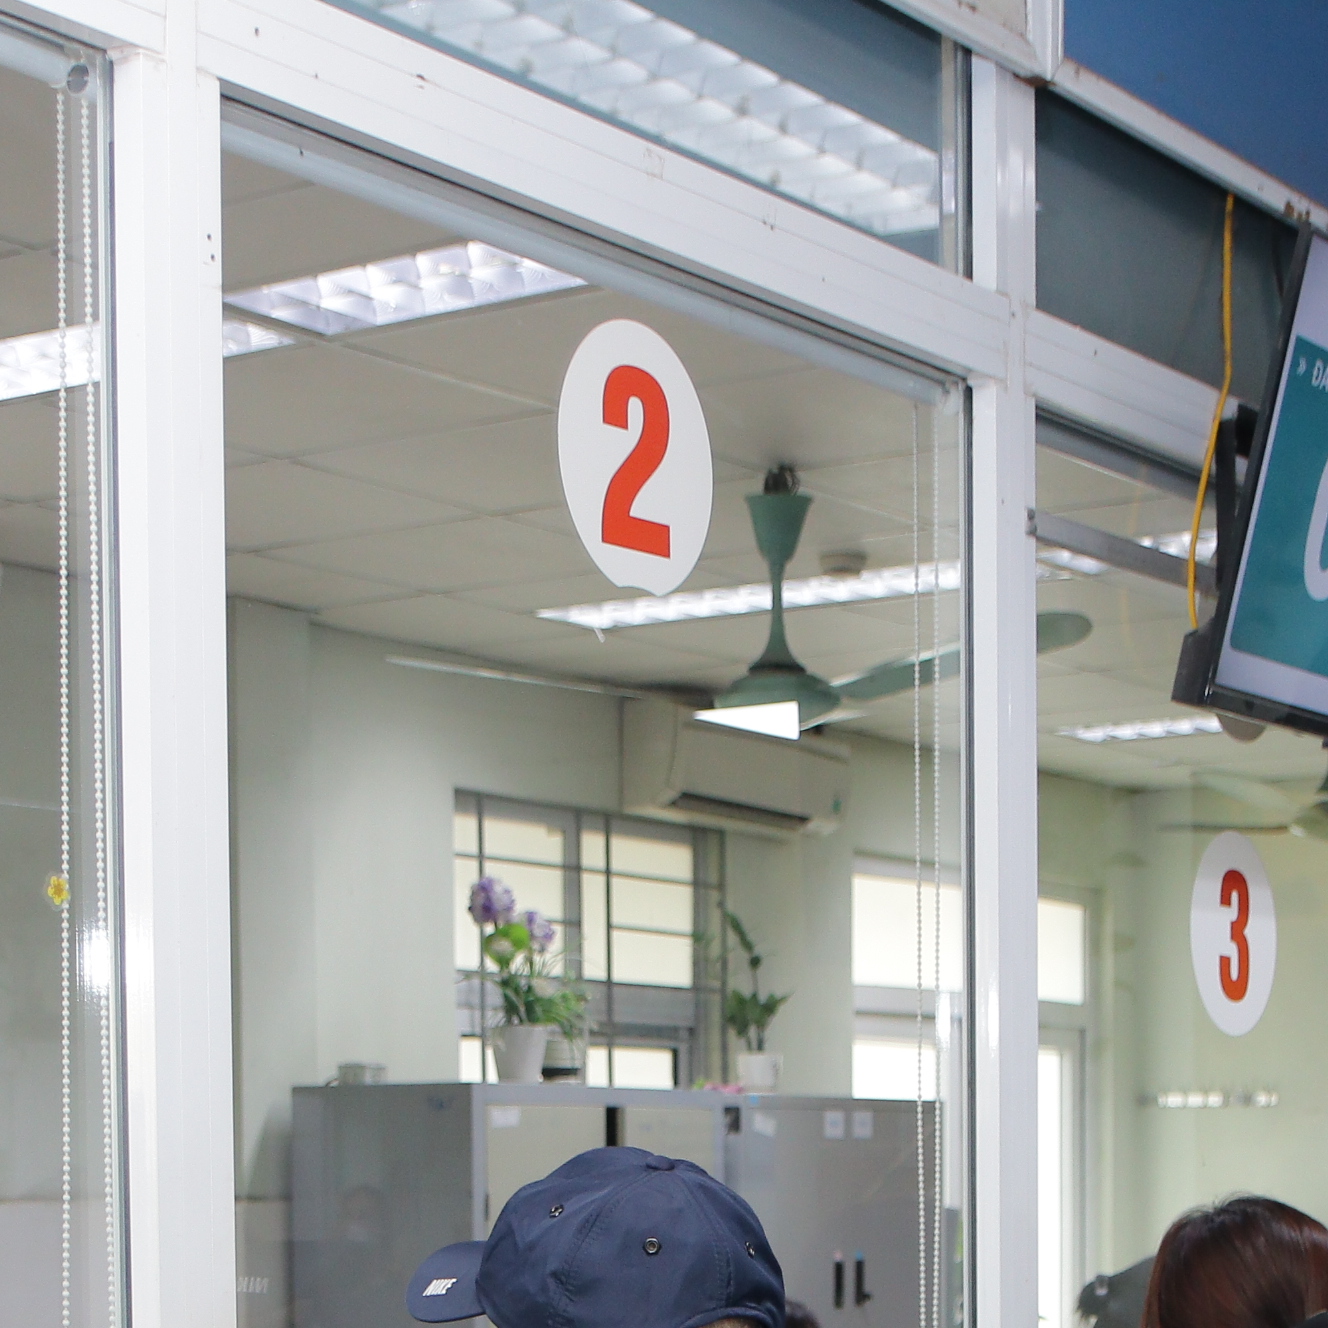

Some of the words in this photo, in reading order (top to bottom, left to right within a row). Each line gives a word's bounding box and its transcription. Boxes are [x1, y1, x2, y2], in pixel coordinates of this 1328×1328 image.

[602, 364, 671, 559] 2
[1220, 870, 1249, 1002] 3
[422, 1278, 458, 1297] NIKE
